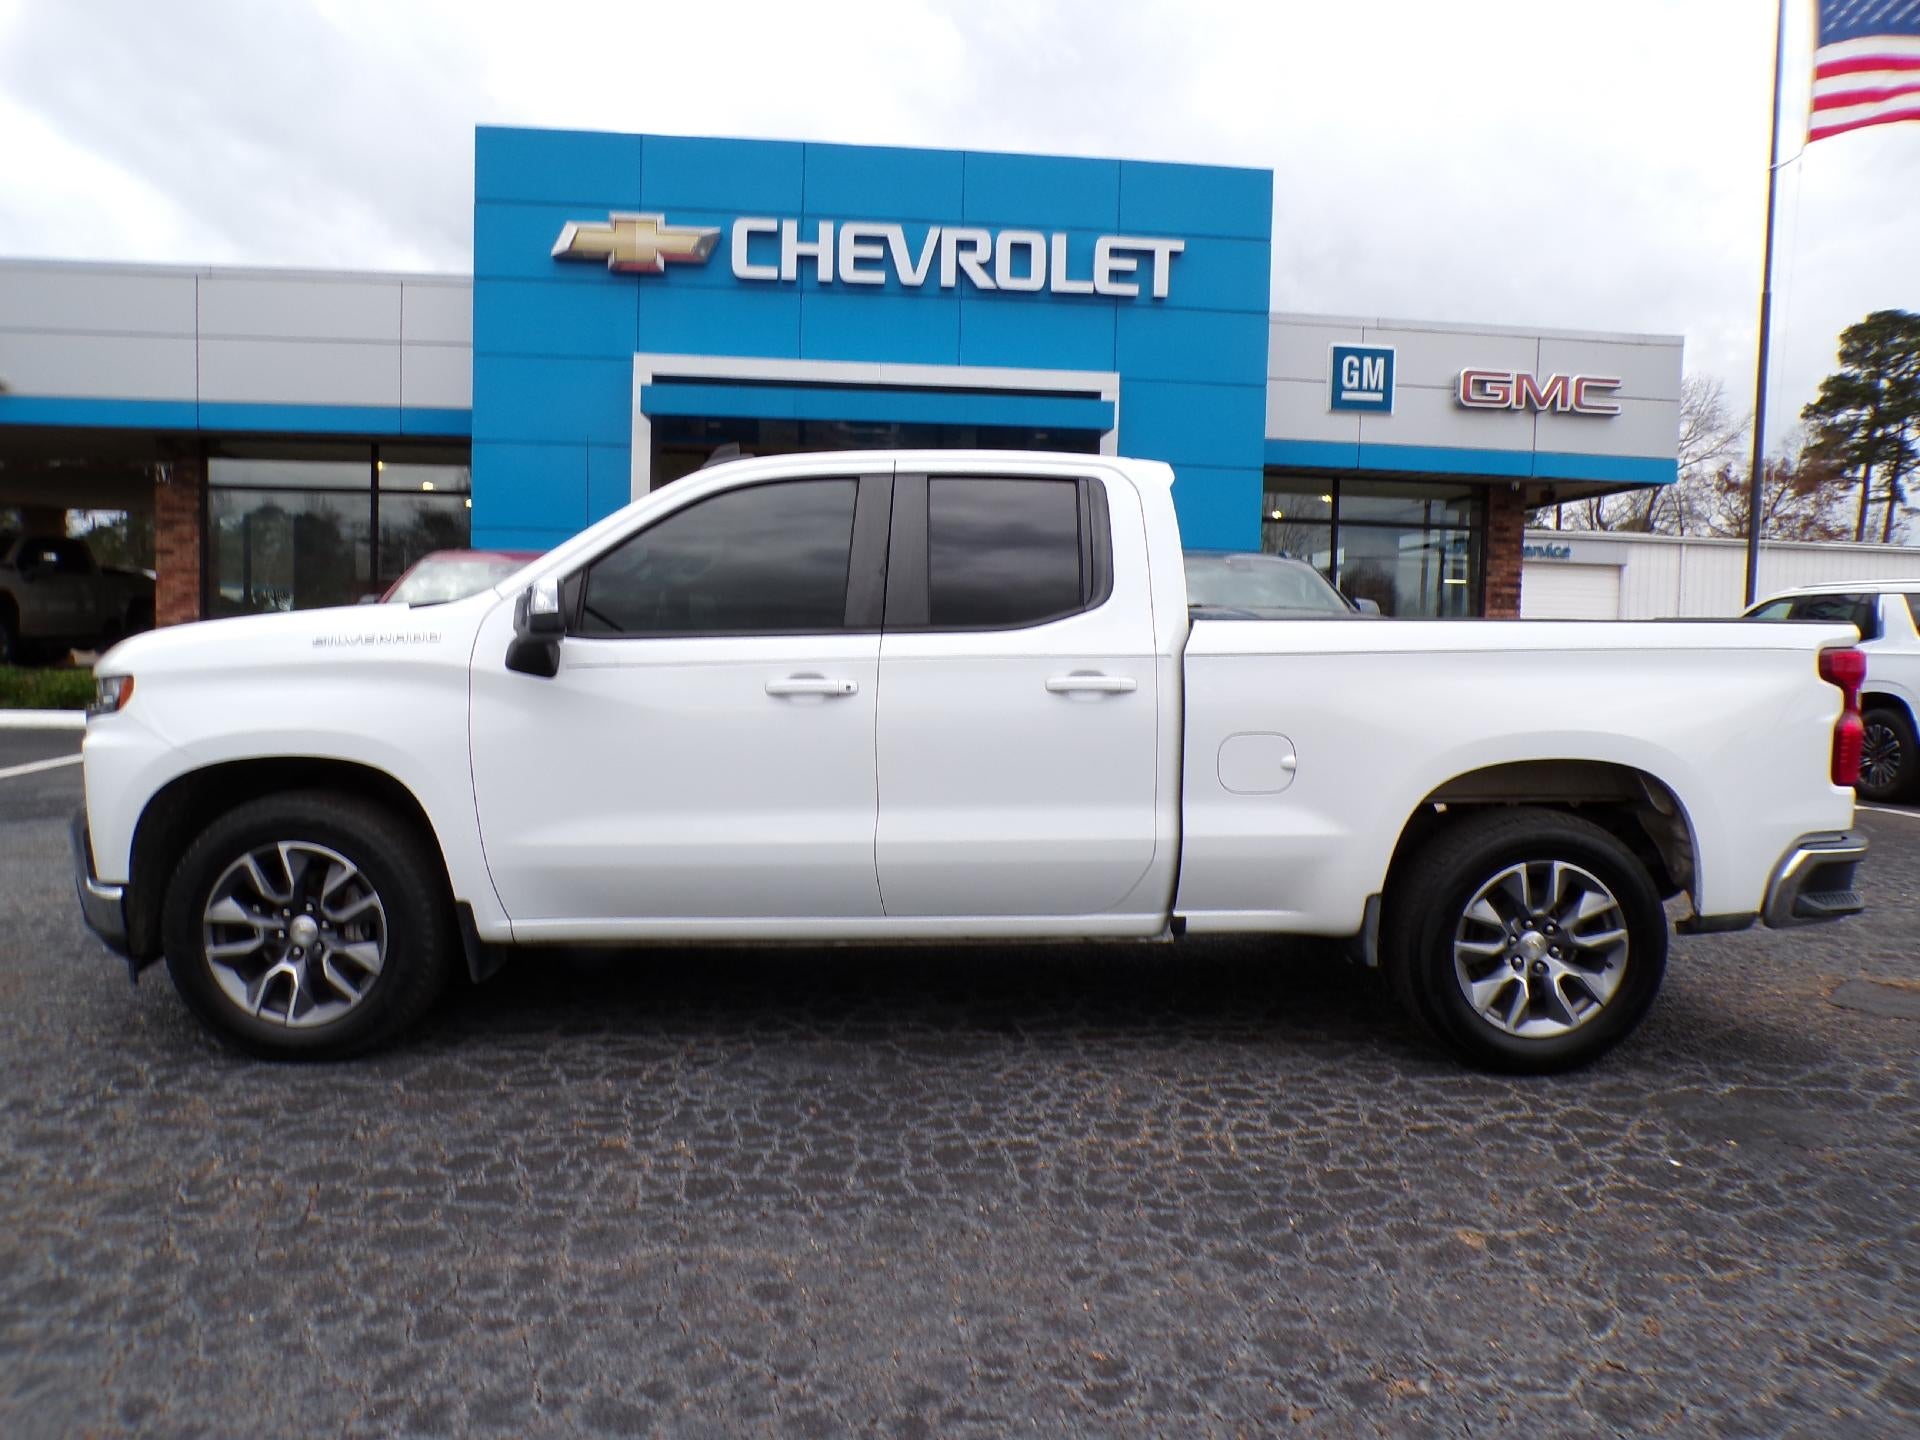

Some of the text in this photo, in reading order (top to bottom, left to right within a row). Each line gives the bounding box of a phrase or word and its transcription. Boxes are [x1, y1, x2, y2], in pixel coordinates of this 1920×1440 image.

[731, 218, 1185, 298] CHEVROLET
[1341, 355, 1385, 391] GM
[1459, 367, 1621, 415] GMC
[1523, 542, 1570, 559] ervice
